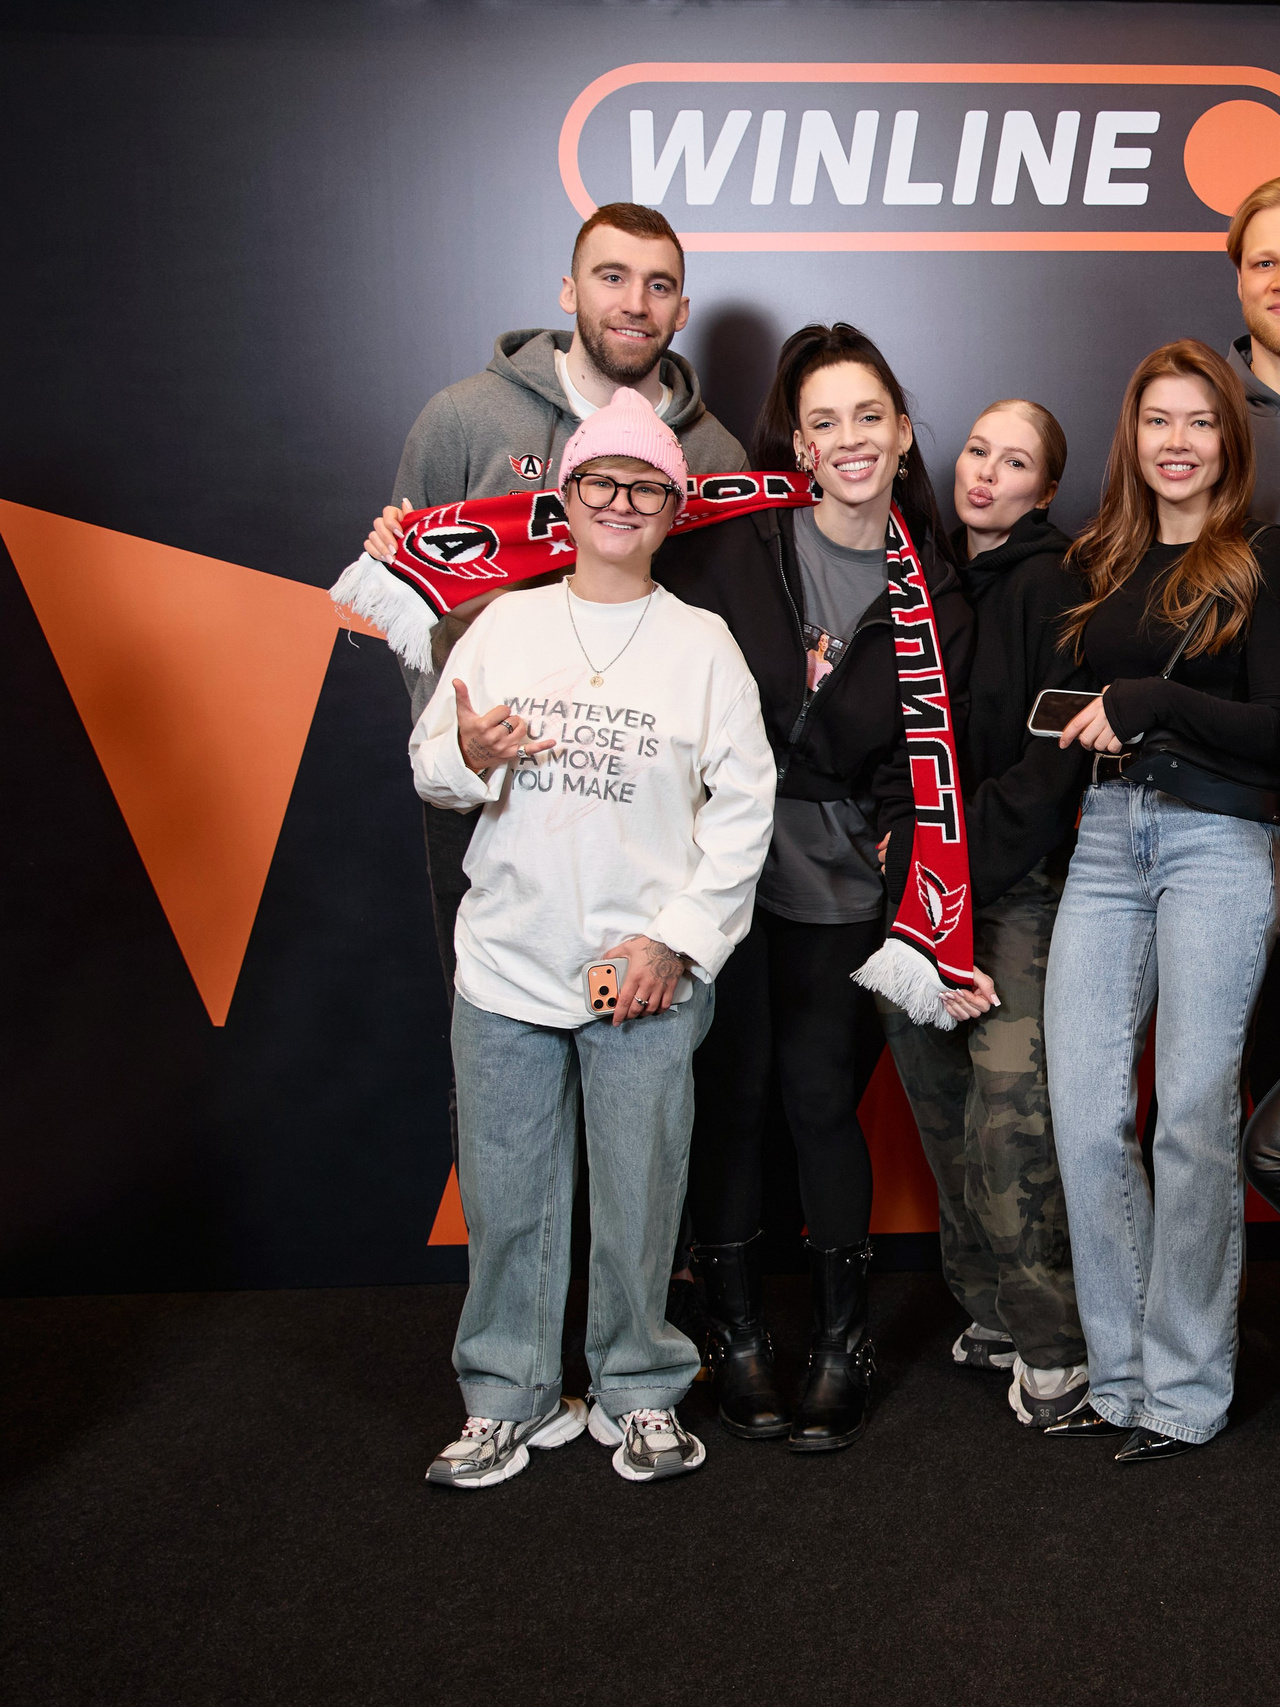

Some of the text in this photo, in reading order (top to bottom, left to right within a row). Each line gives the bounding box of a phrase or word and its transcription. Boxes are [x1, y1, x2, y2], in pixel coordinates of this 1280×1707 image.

[629, 109, 1161, 206] WINLINE
[503, 697, 657, 733] WHATEVER
[561, 722, 626, 752] LOSE
[637, 735, 660, 758] IS
[547, 748, 625, 776] MOVE
[509, 769, 637, 804] YOU MAKE
